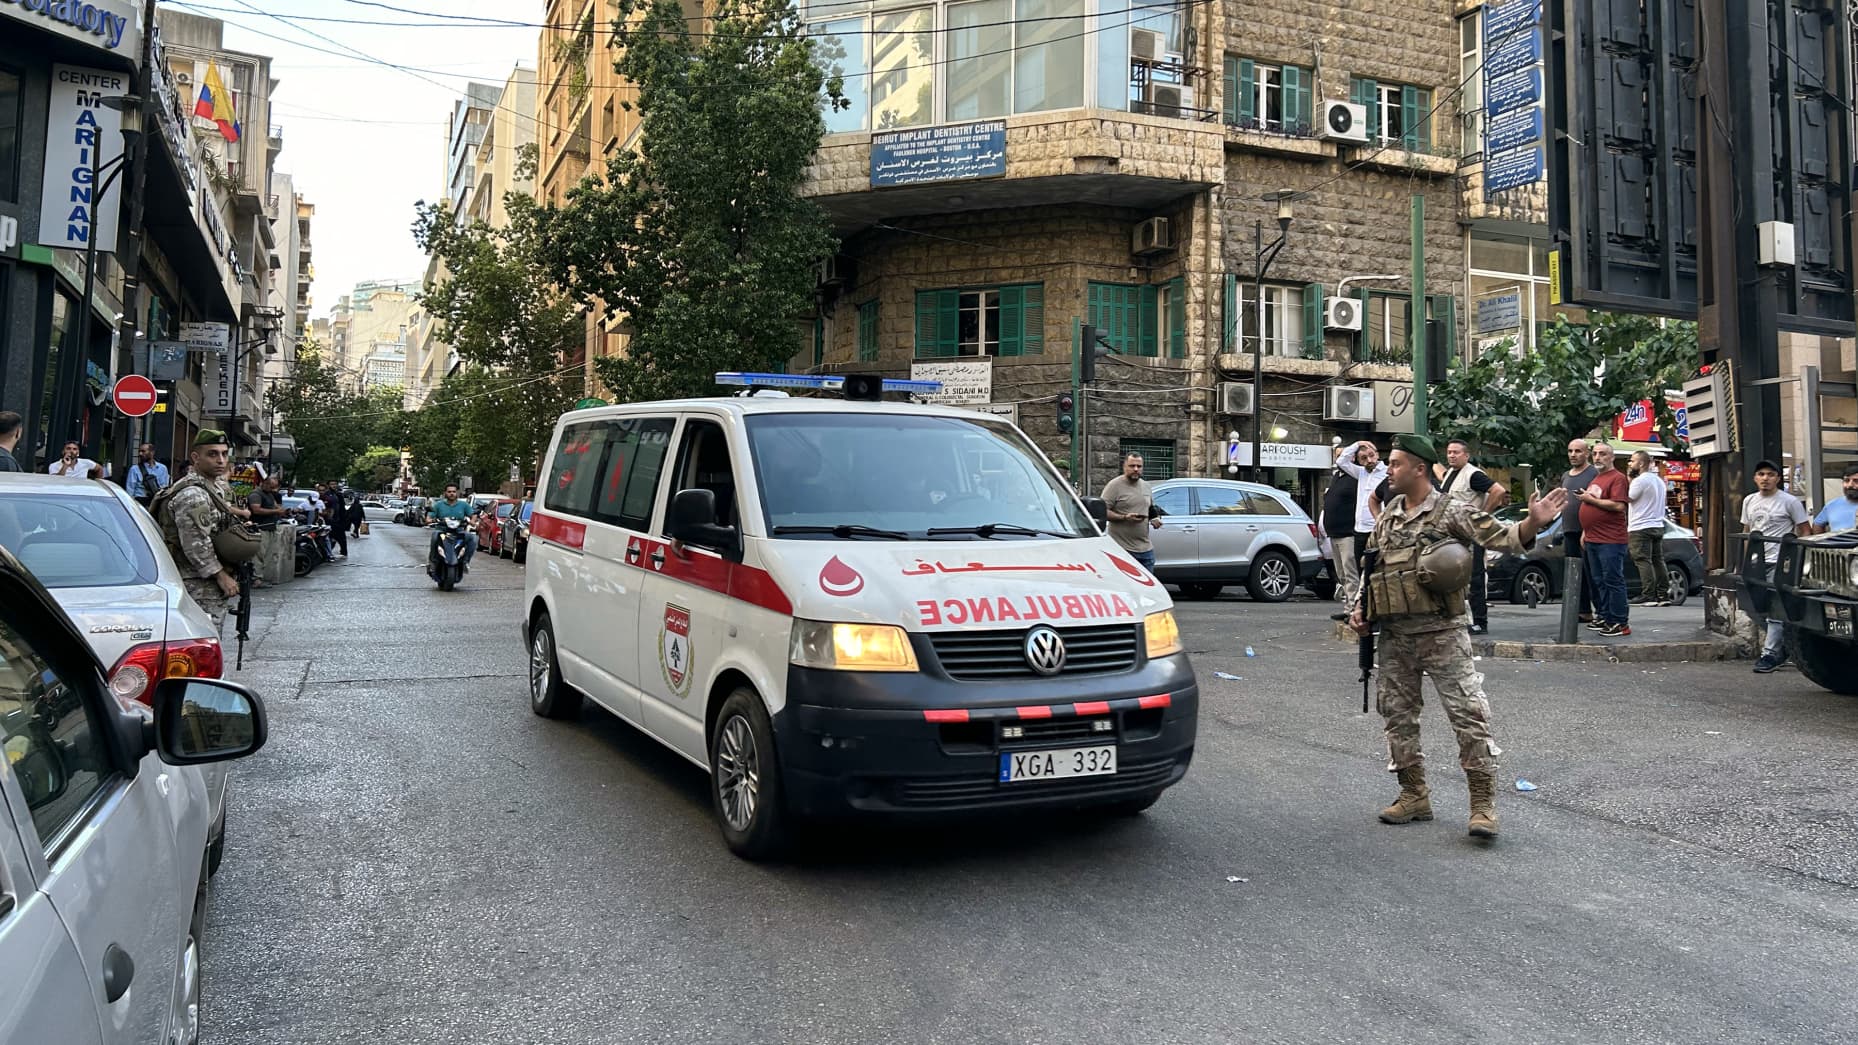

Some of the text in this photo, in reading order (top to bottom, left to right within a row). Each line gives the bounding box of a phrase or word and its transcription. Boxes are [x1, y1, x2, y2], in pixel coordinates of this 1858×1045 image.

[58, 70, 121, 89] CENTER
[873, 122, 1004, 145] BEIRUT IMPLANT DENTISTRY CENTRE
[941, 154, 973, 164] بيروت
[975, 150, 1003, 161] مركز
[67, 90, 102, 242] MARIGNAN
[1497, 294, 1517, 304] Khalil
[1624, 402, 1647, 423] 24h
[902, 559, 1103, 579] إسعاف
[90, 623, 154, 634] COROLLA
[1014, 749, 1112, 778] XGA 332
